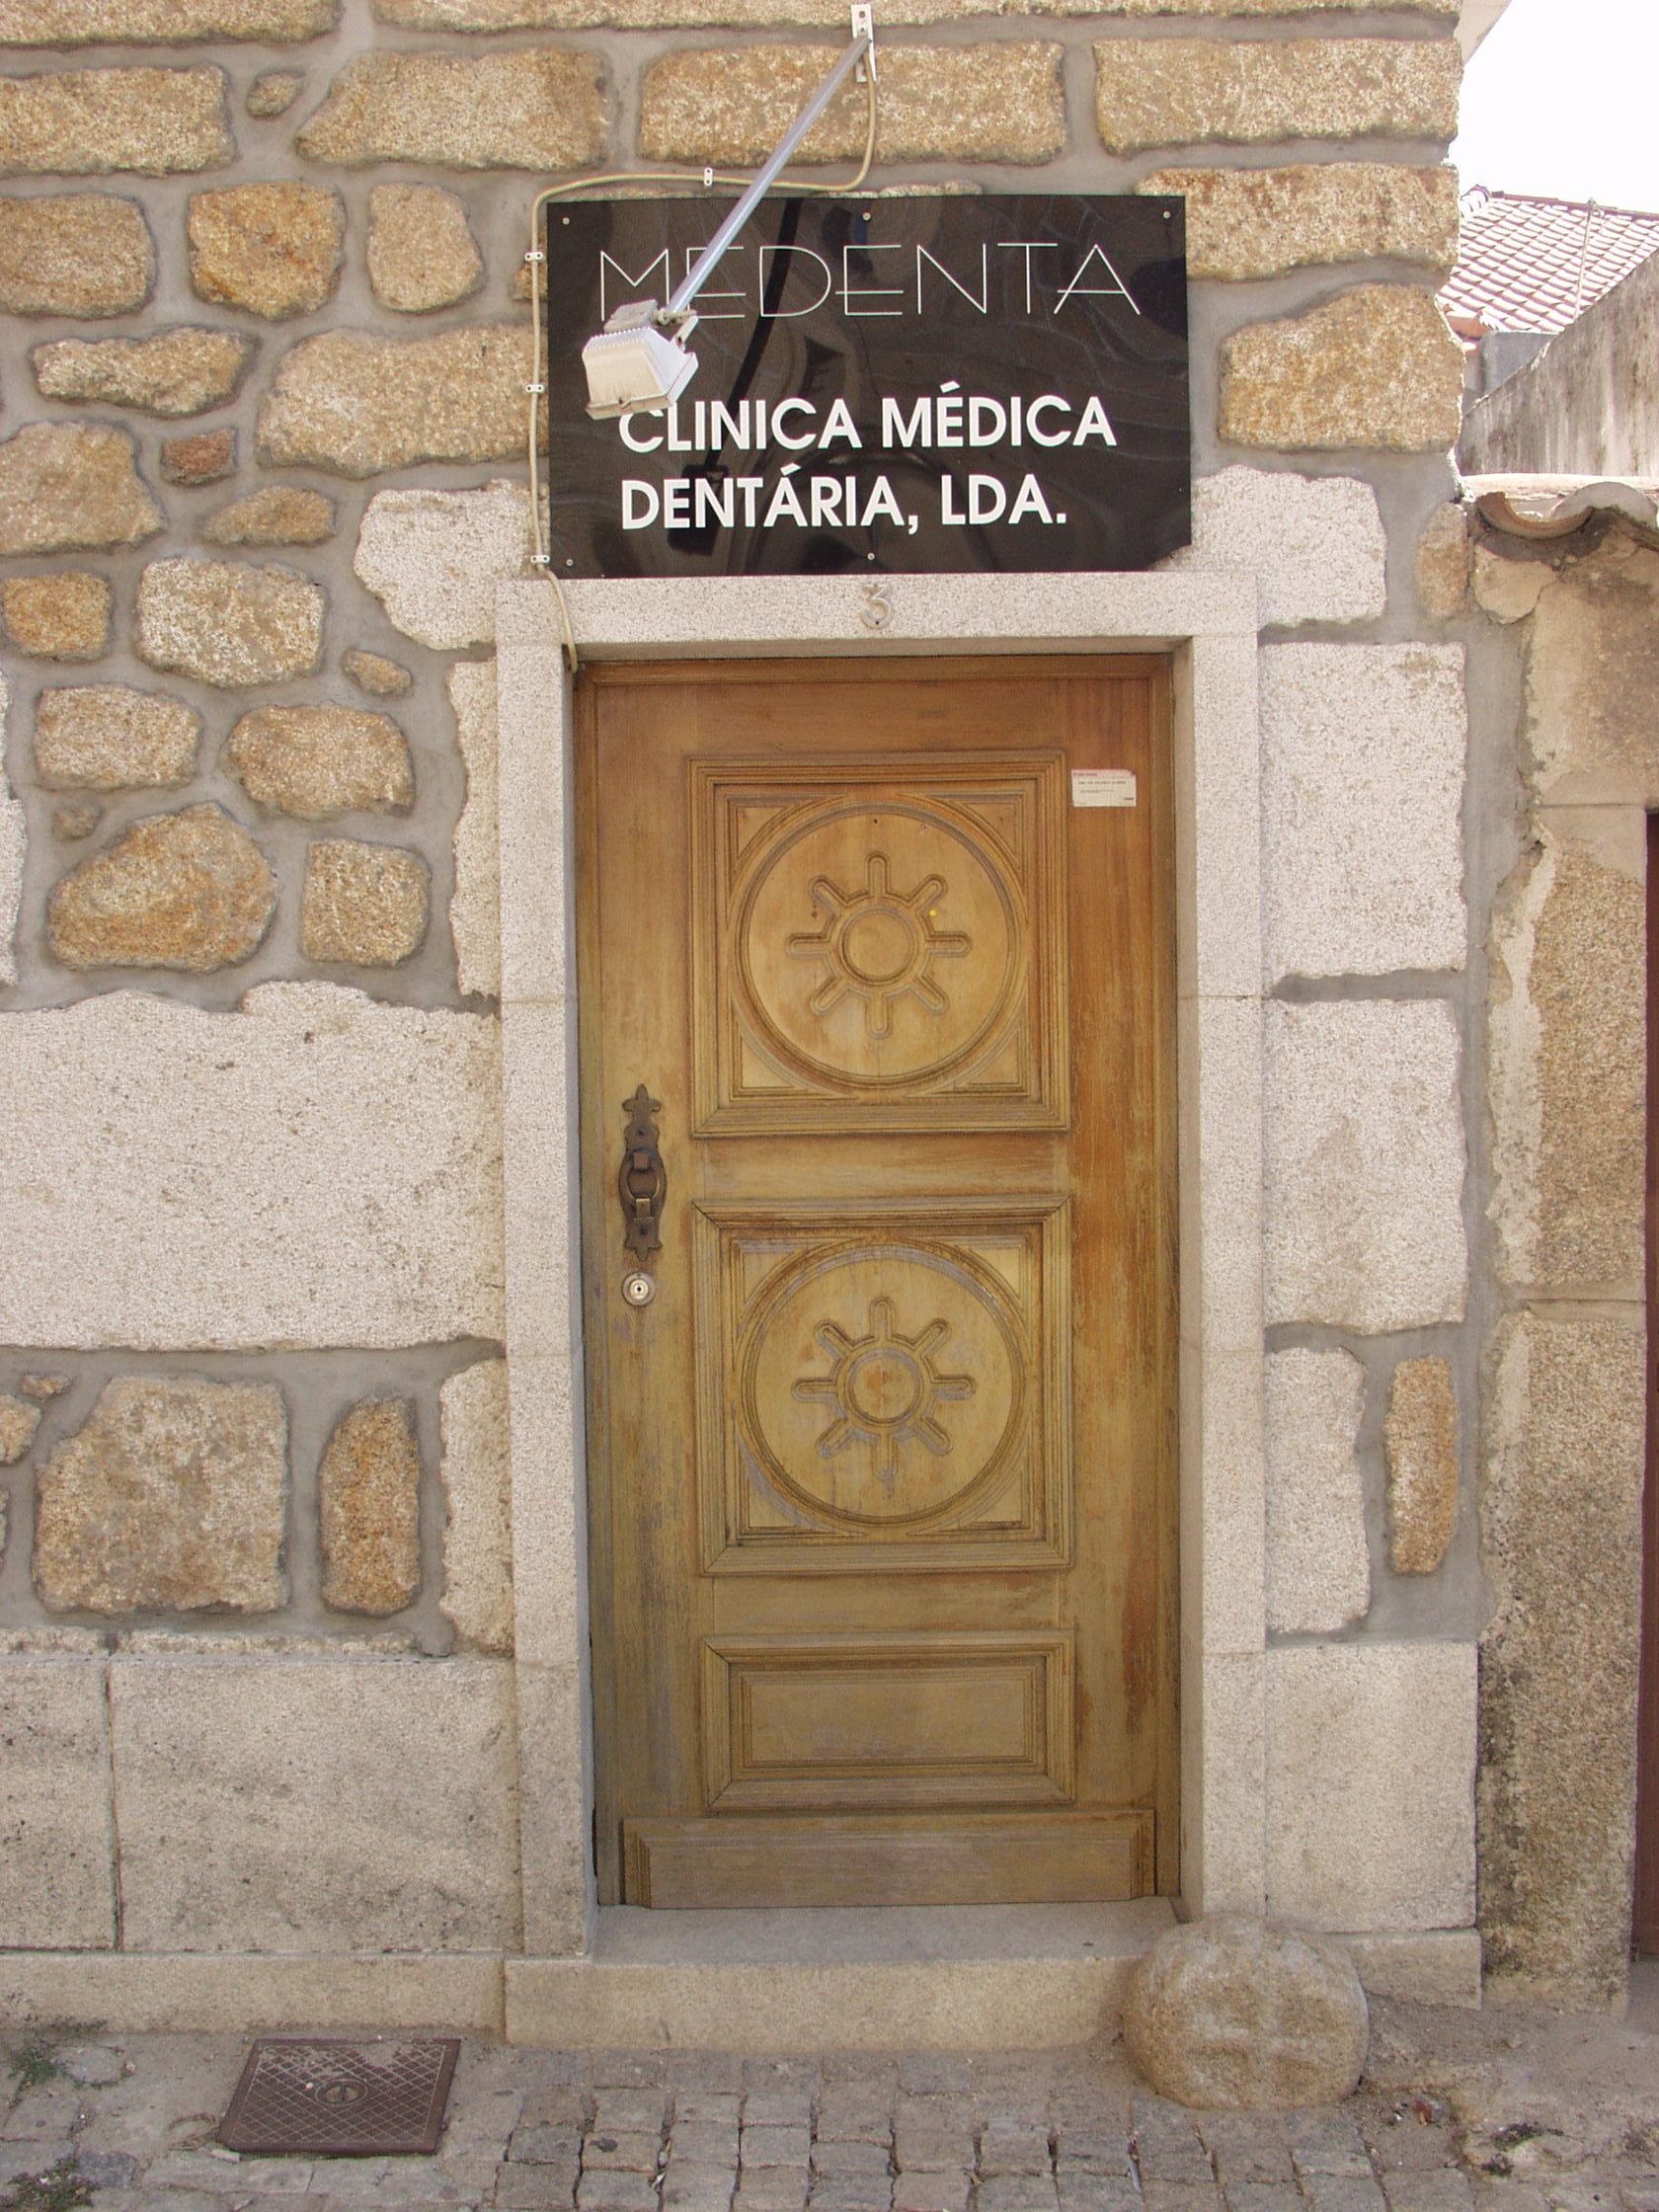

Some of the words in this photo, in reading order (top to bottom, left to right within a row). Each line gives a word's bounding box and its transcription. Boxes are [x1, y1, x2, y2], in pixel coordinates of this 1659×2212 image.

[600, 243, 1142, 321] MEDENTA
[618, 396, 863, 453] CLINICA
[882, 381, 1117, 449] MÉDICA
[621, 463, 919, 535] DENTÁRIA,
[941, 473, 1067, 525] LDA.
